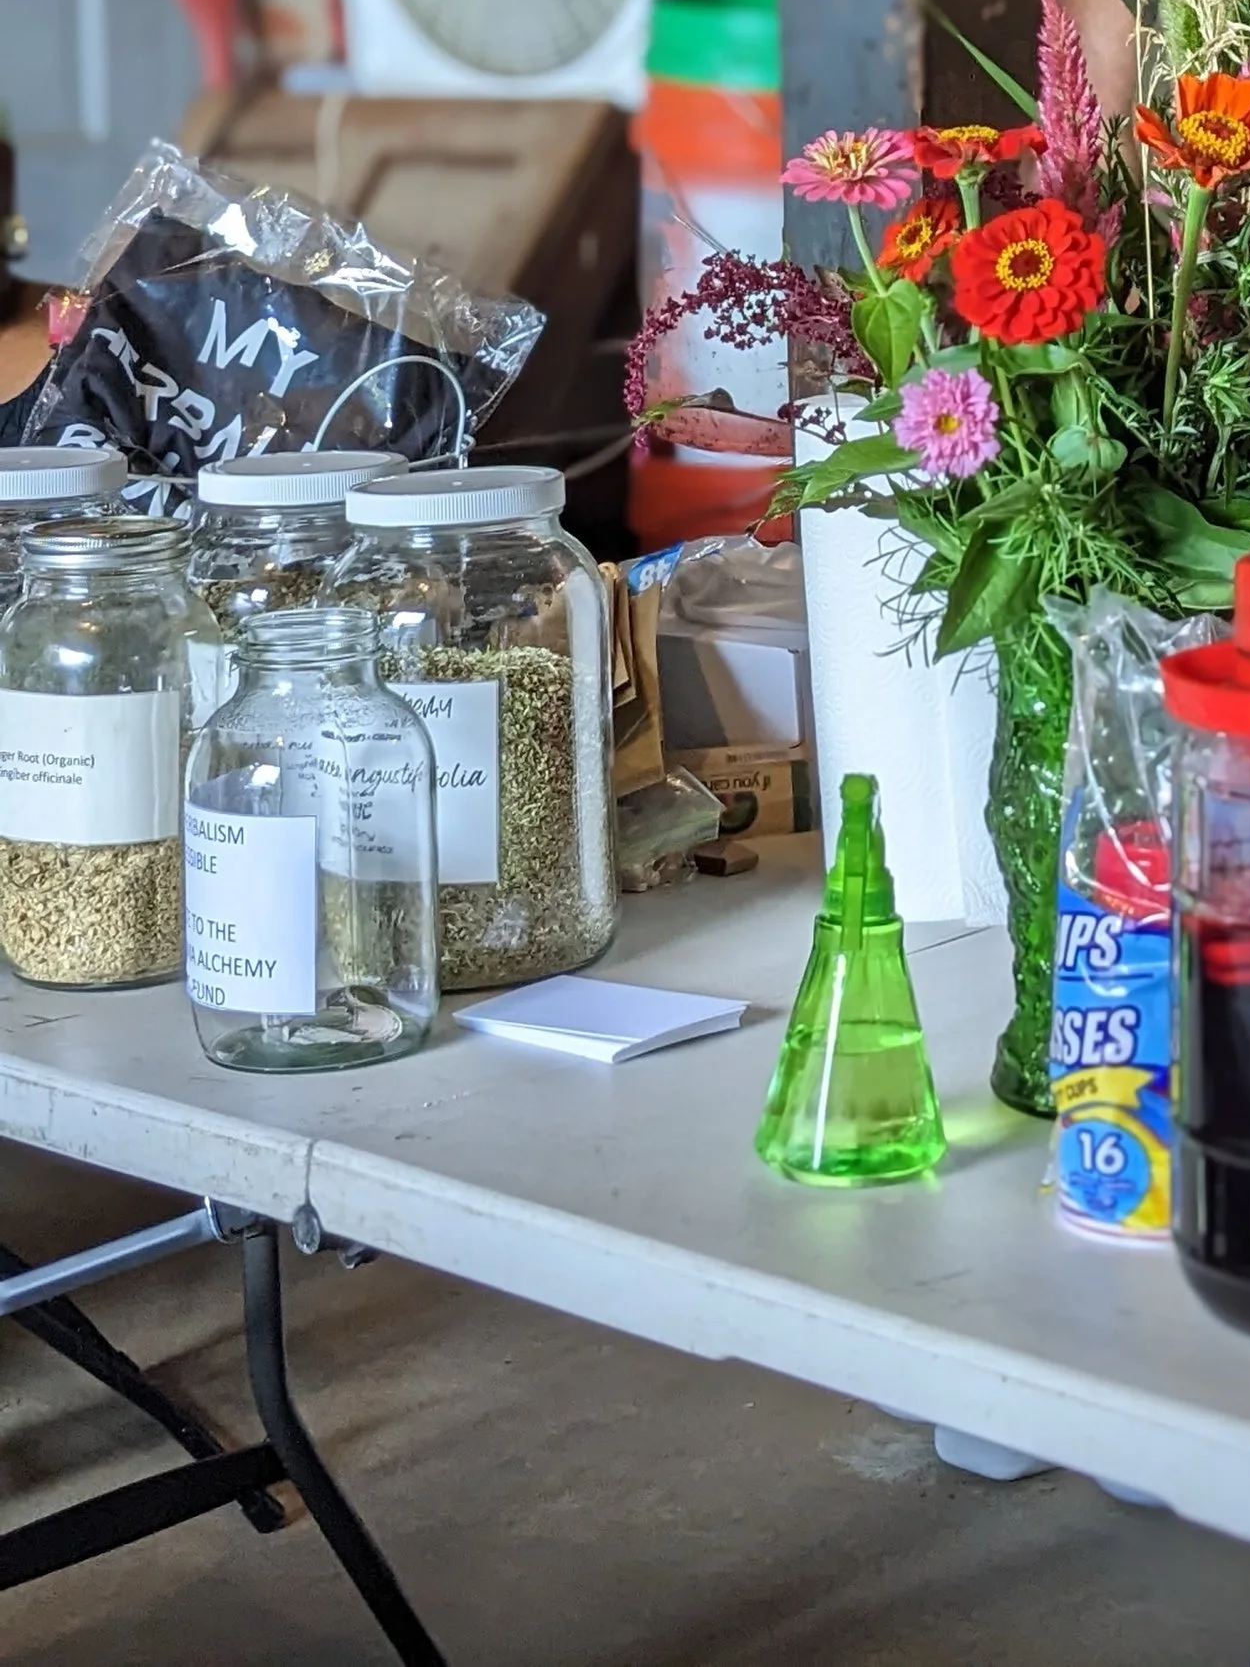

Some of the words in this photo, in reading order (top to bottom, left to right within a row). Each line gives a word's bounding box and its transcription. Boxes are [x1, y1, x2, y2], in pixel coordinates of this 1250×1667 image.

[198, 299, 319, 398] MY
[17, 750, 40, 764] Root
[42, 753, 95, 769] (Organic)
[0, 765, 31, 782] ingiber
[32, 770, 83, 785] officinale
[207, 919, 237, 943] THE
[197, 949, 278, 979] ALCHEMY
[191, 979, 226, 1006] FUND
[1078, 1130, 1126, 1176] 16
